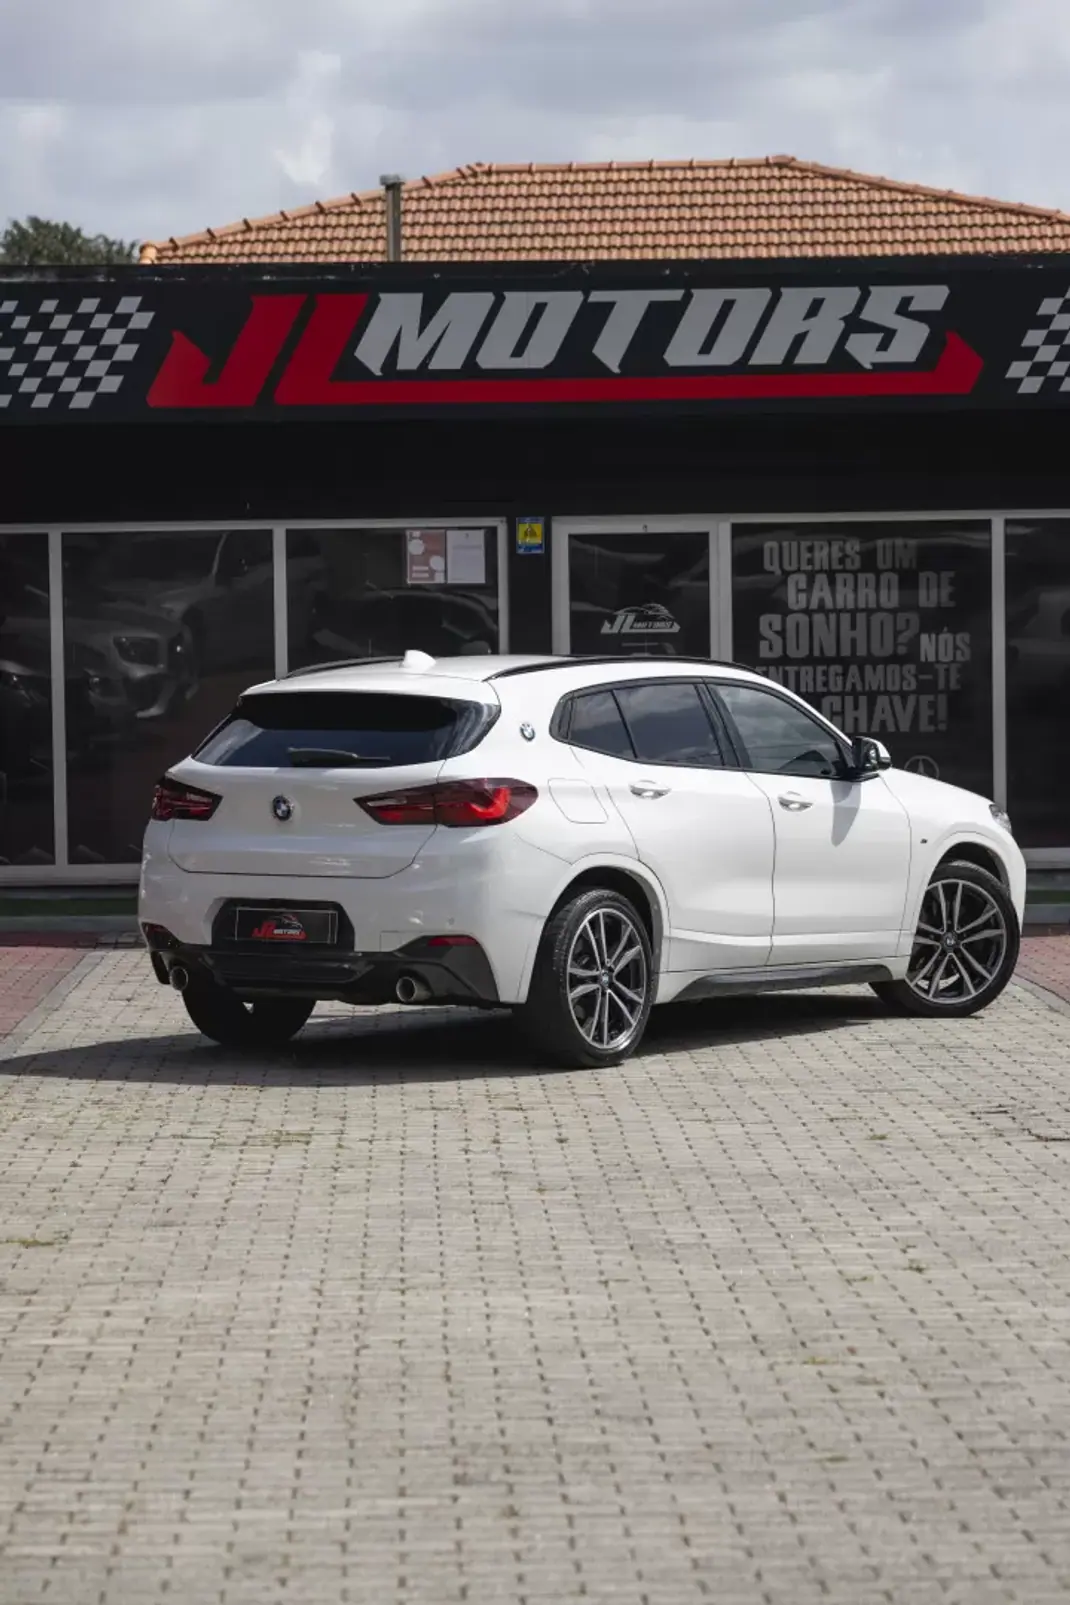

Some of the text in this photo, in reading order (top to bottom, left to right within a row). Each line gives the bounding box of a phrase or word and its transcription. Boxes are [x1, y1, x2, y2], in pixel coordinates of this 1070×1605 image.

[354, 284, 950, 375] MOTORS
[763, 538, 917, 576] QUERES UM
[787, 571, 956, 610] CARRO DE
[759, 612, 971, 664] SONHO? NÓS
[821, 694, 949, 734] CHAVE!
